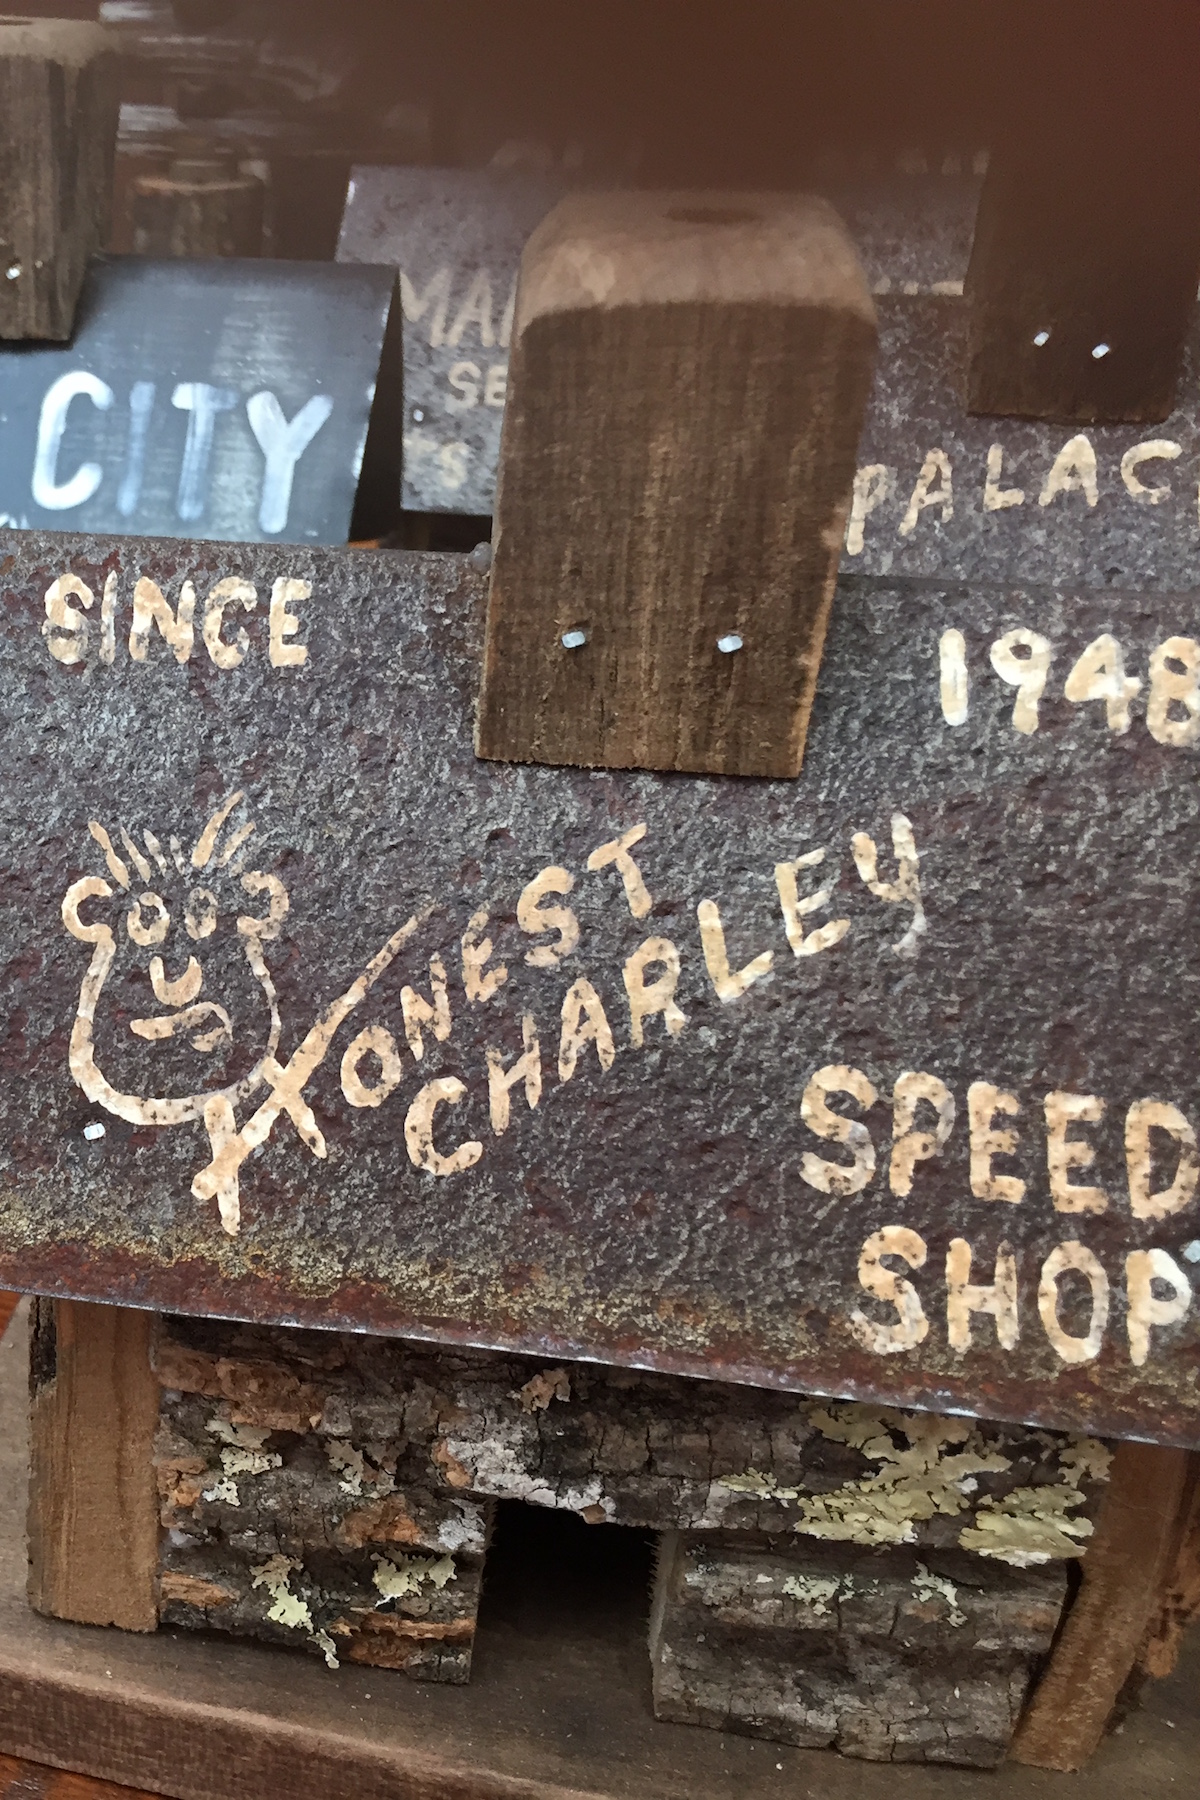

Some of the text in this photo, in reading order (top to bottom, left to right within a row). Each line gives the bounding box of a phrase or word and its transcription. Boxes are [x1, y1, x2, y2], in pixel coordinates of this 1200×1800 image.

[400, 267, 519, 349] MA
[31, 370, 334, 534] CITY
[846, 433, 1200, 557] PALAC
[41, 570, 314, 670] SINCE
[939, 626, 1200, 747] 1948
[403, 813, 928, 1177] CHARLEY
[800, 1063, 1200, 1221] SPEED
[849, 1225, 1193, 1367] SHOP
